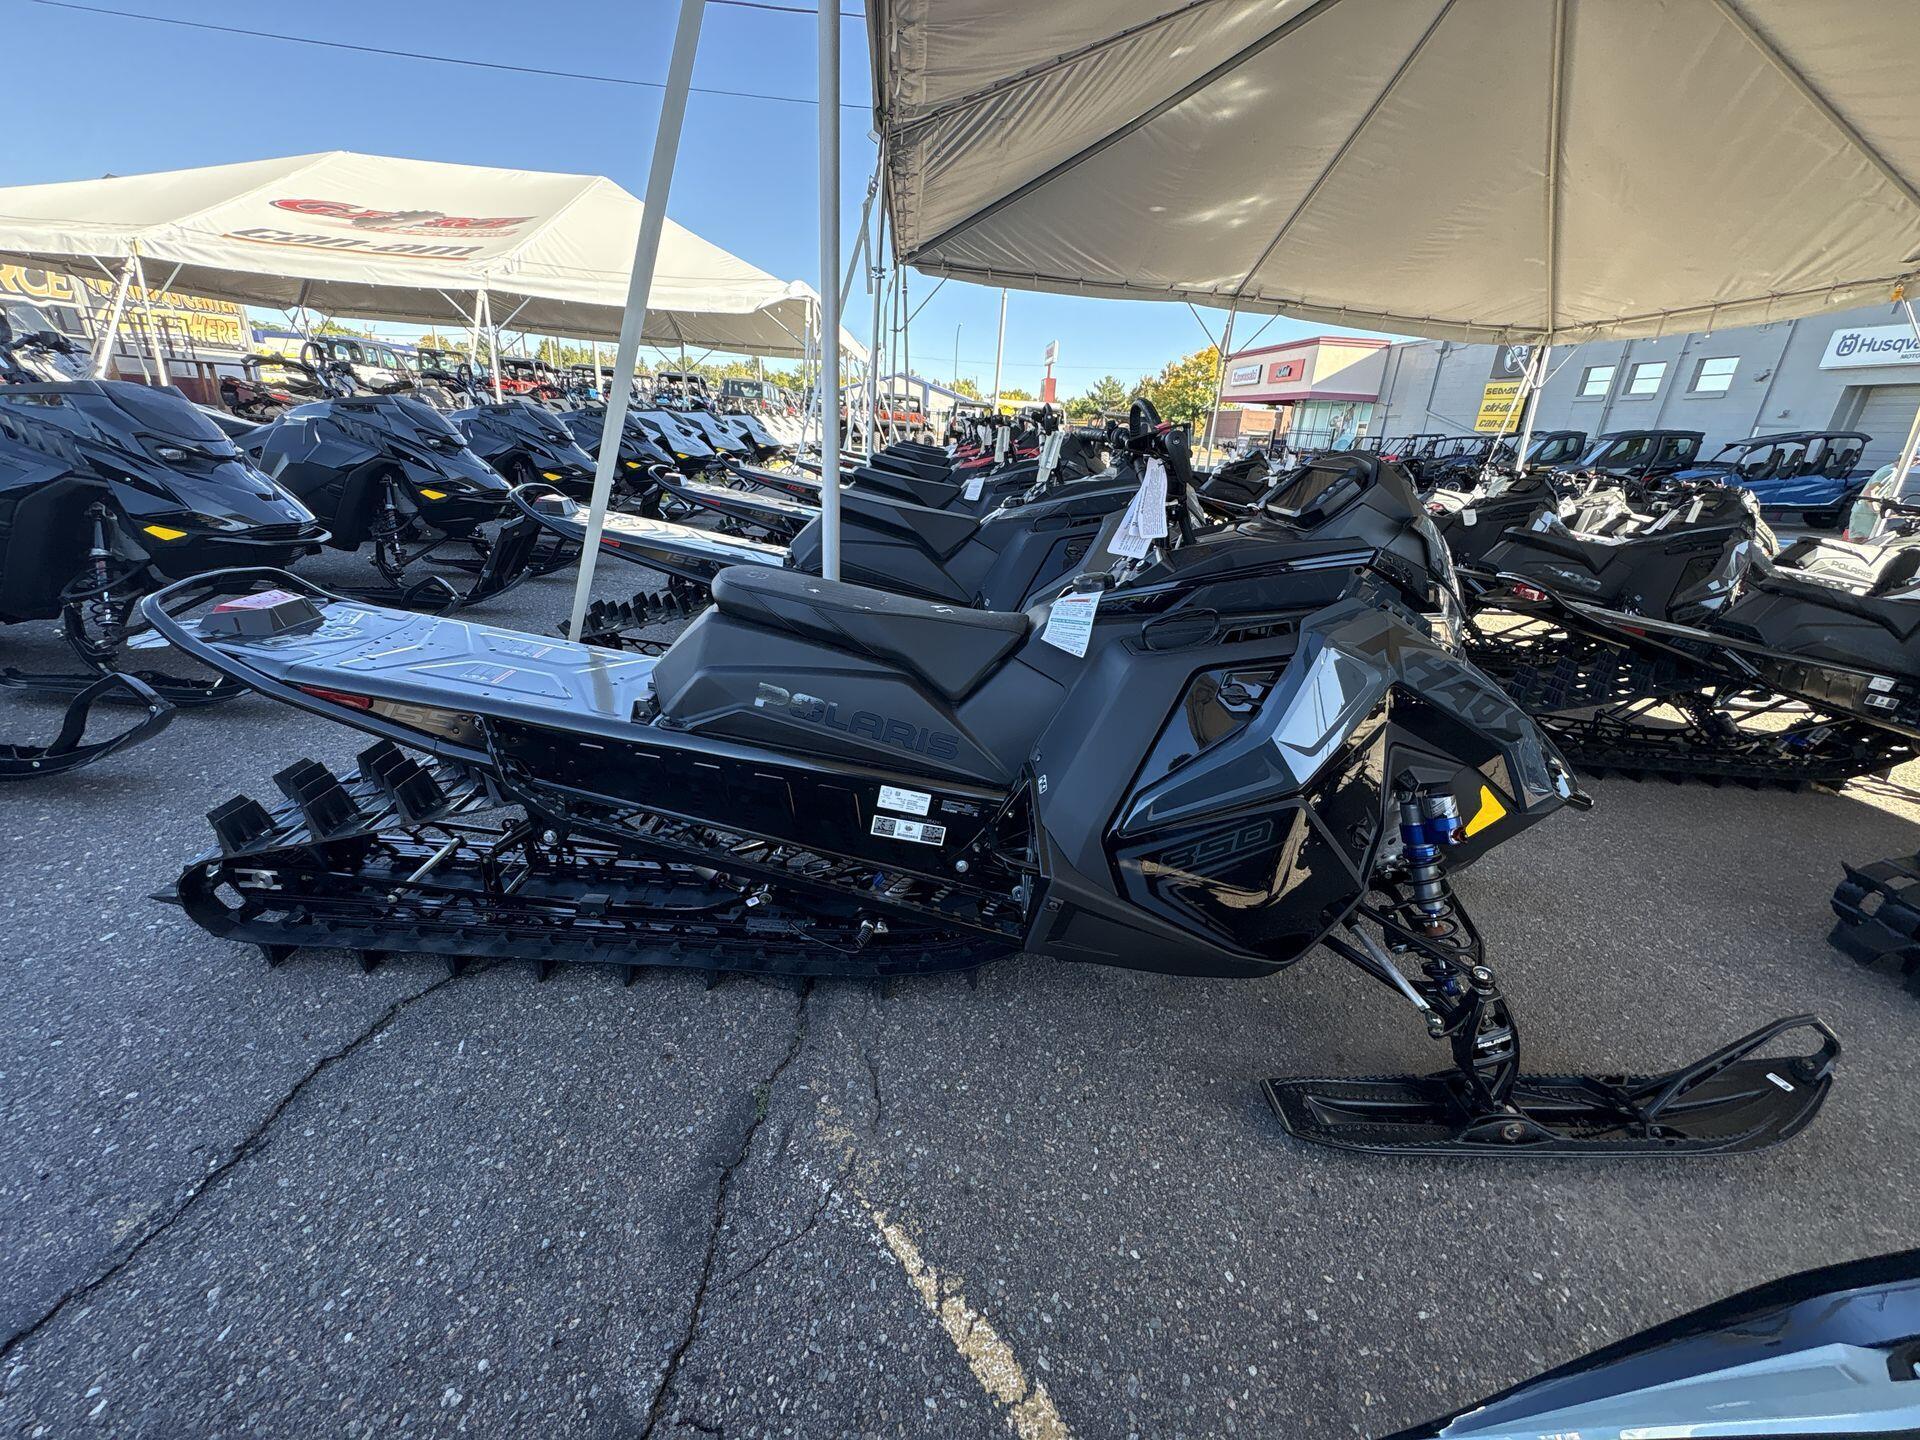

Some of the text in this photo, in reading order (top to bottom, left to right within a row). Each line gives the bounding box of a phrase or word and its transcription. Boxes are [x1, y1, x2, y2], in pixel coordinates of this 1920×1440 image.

[191, 313, 241, 345] HERE
[1831, 560, 1874, 579] POLARIS
[754, 682, 960, 760] POLARIS
